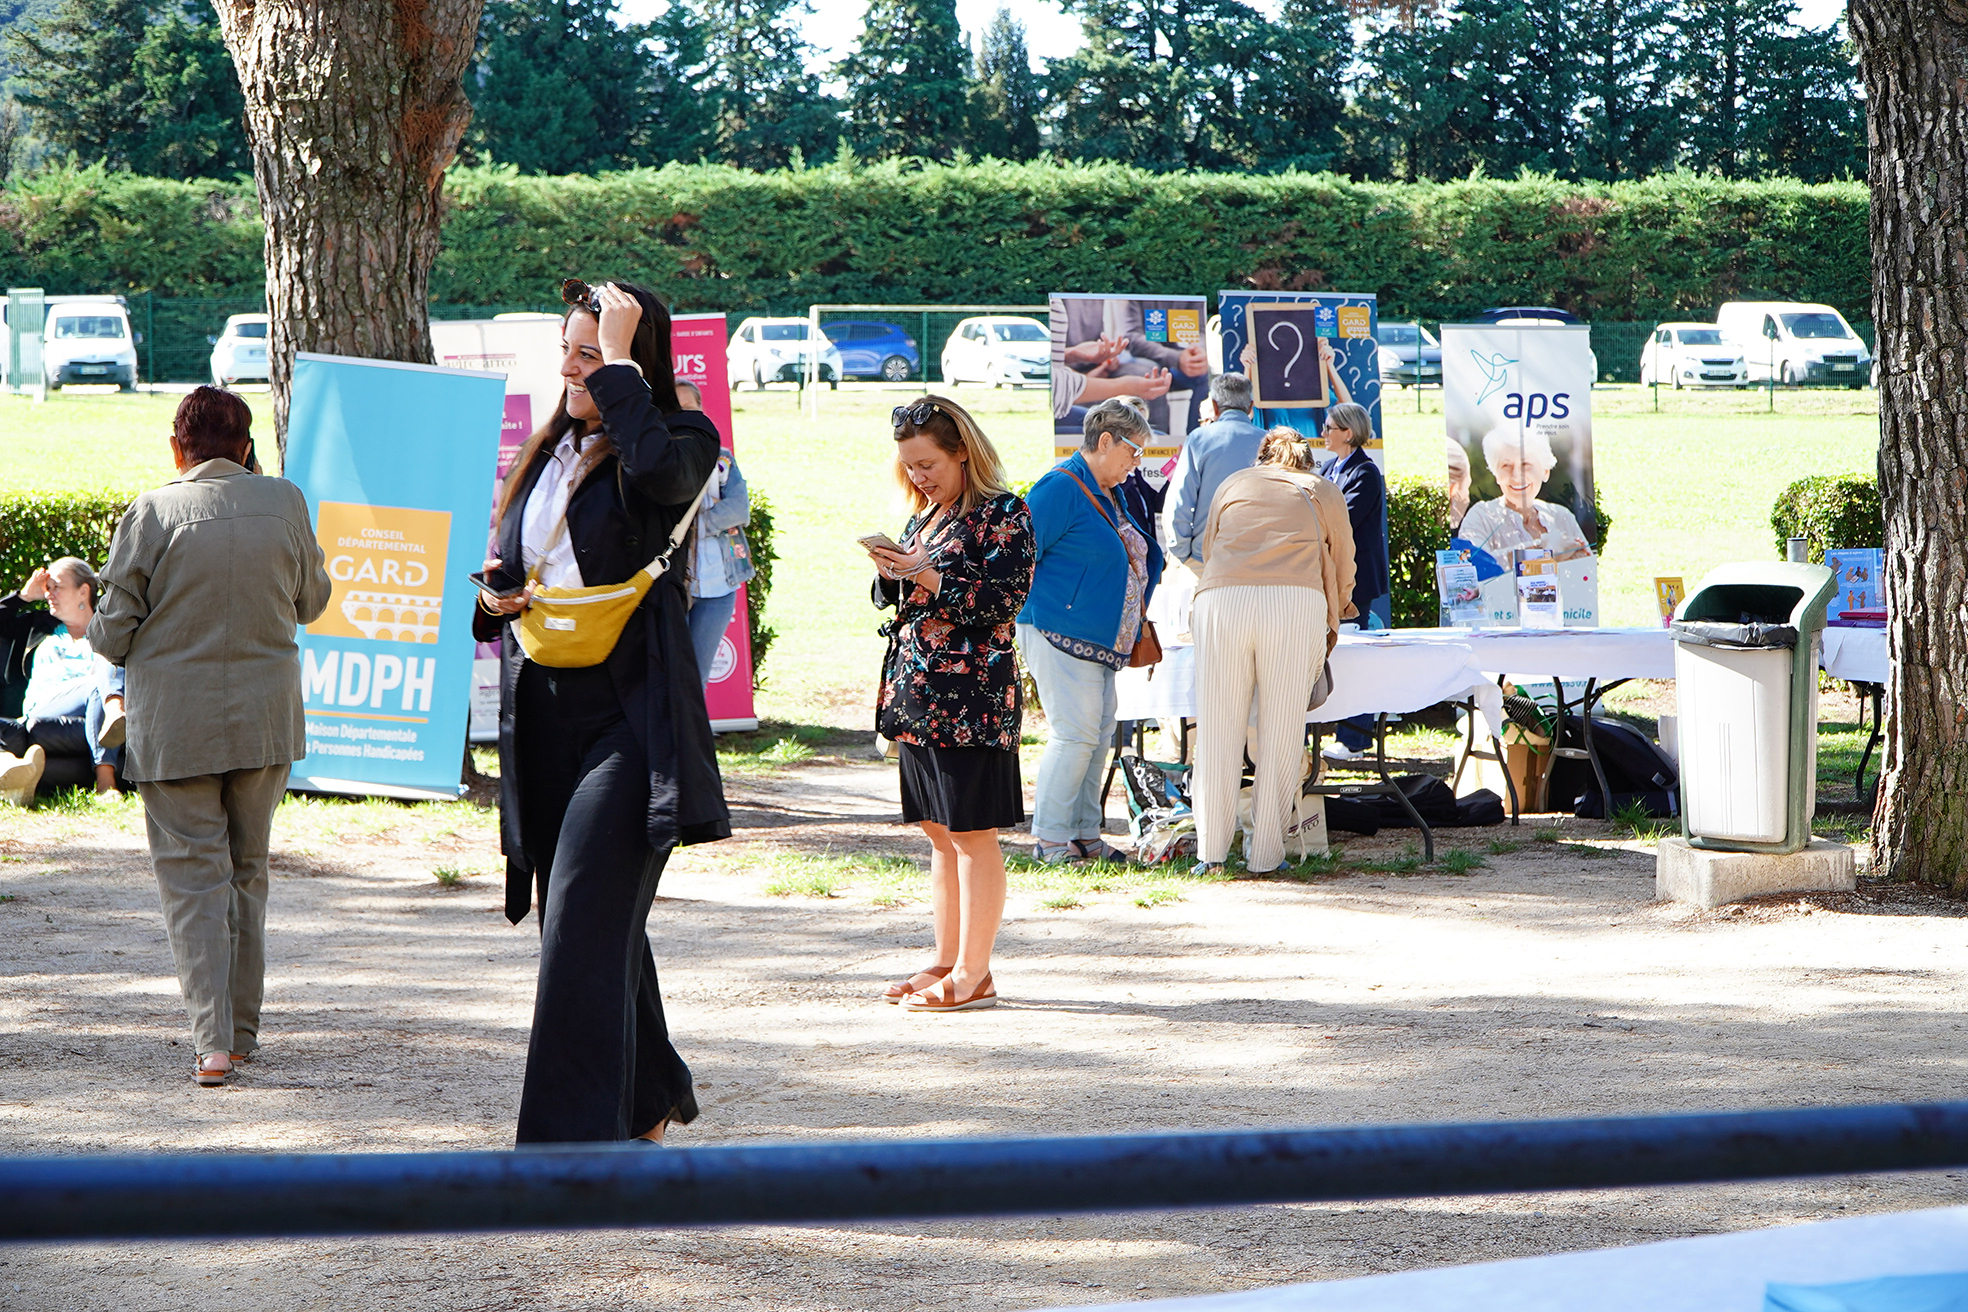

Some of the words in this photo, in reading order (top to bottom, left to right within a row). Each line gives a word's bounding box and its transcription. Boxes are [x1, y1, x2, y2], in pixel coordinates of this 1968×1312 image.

[1172, 322, 1196, 330] GARD
[673, 354, 706, 374] urs
[1503, 392, 1570, 428] aps
[1142, 467, 1166, 478] fess
[361, 528, 405, 540] CONSEIL
[338, 536, 426, 554] DÉPARTEMENTAL
[329, 555, 429, 587] GARD
[1494, 610, 1503, 619] et
[302, 648, 436, 712] MDPH
[306, 722, 339, 738] Maison
[340, 724, 417, 743] Départementale
[312, 740, 362, 757] Personnes
[363, 744, 424, 761] Handicapées
